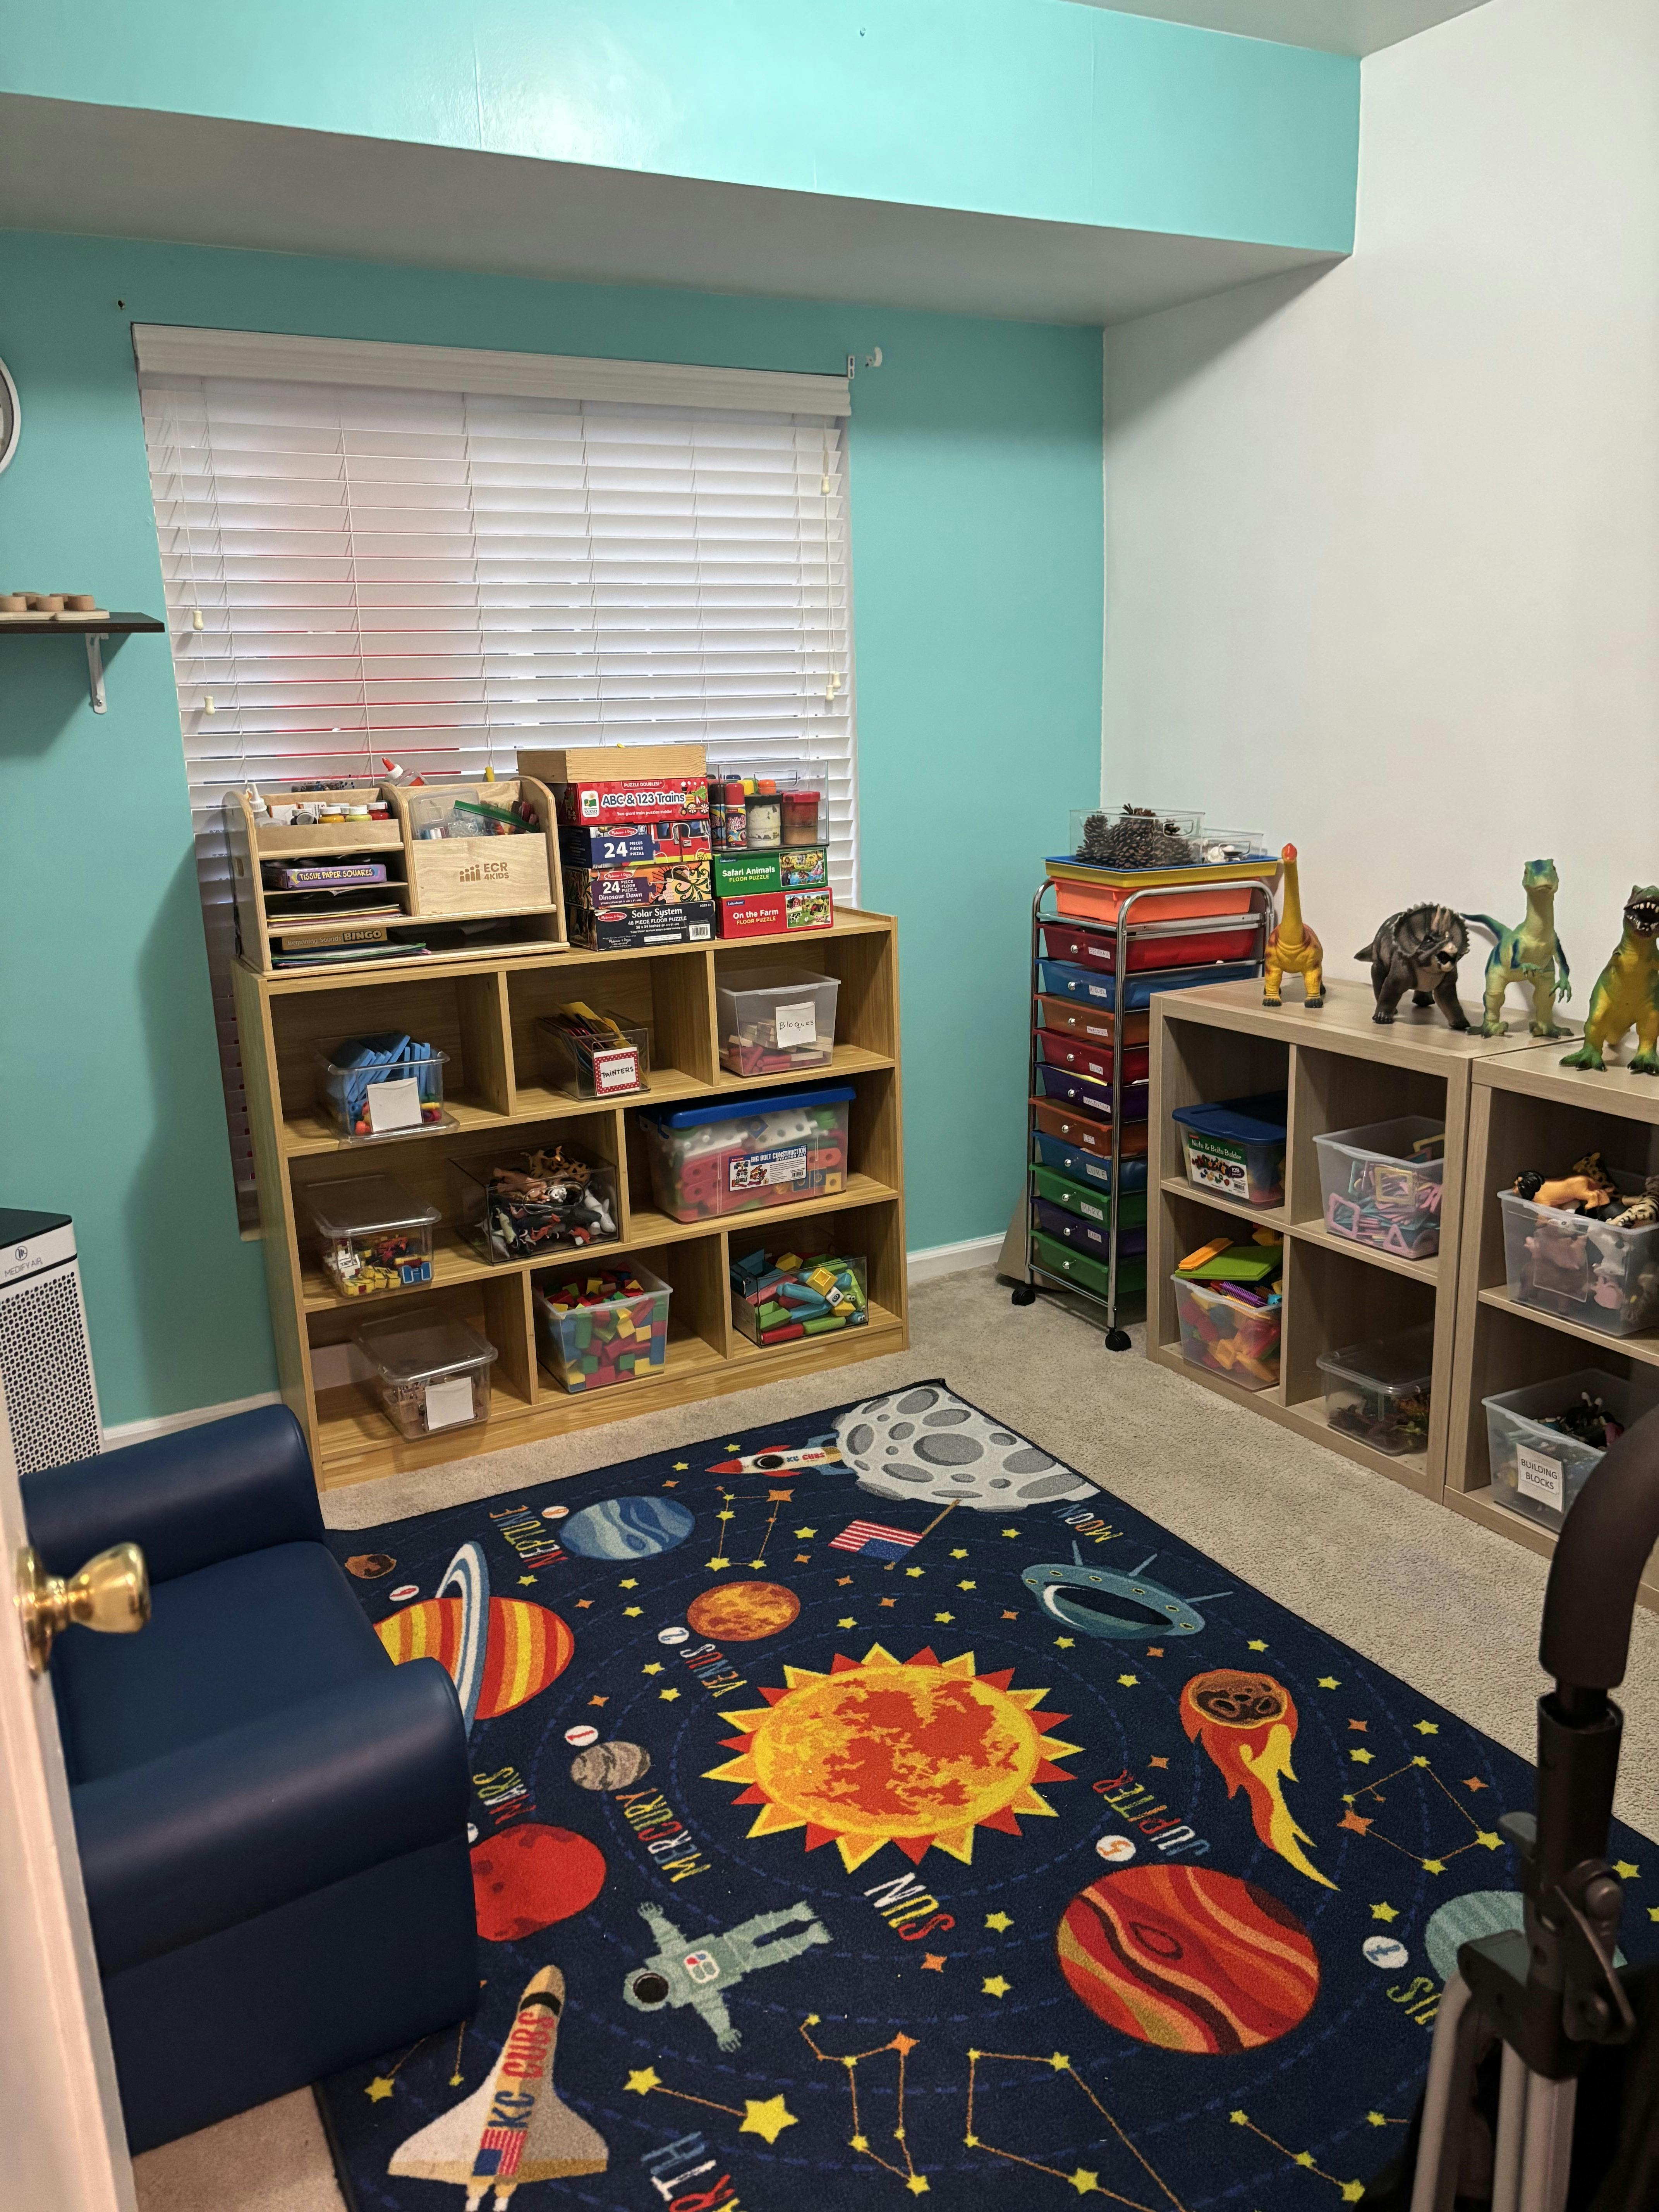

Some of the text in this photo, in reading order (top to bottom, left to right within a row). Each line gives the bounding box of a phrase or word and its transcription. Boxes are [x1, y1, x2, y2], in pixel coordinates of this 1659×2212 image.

[602, 792, 685, 806] ABC & 123 Trains
[604, 842, 628, 858] 24
[299, 872, 321, 881] TISSUE
[343, 869, 373, 878] SQUARES
[484, 862, 508, 872] ECR
[722, 866, 775, 877] Safari Animals
[484, 872, 509, 880] 4KIDS
[603, 881, 620, 894] 24
[632, 908, 682, 918] Solar System
[287, 938, 318, 946] Beginning
[343, 930, 381, 942] BINGO
[779, 1020, 814, 1031] Bloques
[772, 1147, 807, 1159] CONSTRUCTION
[1192, 1139, 1204, 1149] Nuts
[1211, 1145, 1224, 1155] Bolts
[1224, 1149, 1242, 1160] Builder
[1087, 1166, 1107, 1179] LUKE
[1082, 1203, 1102, 1219] MARK
[5, 1257, 41, 1277] MEDIFY AIR
[1521, 1459, 1557, 1479] BUILDING
[1526, 1472, 1554, 1489] BLOCKS
[1052, 1504, 1123, 1543] MOON
[489, 1505, 568, 1569] NEPTUNE
[680, 1644, 747, 1697] VENUS
[472, 1767, 536, 1825] MARS
[1092, 1769, 1211, 1856] JUPITER
[615, 1788, 712, 1883] MERCURY
[864, 1872, 955, 1941] SUN
[488, 2011, 555, 2128] KC CUBS
[641, 2130, 740, 2212] RTH
